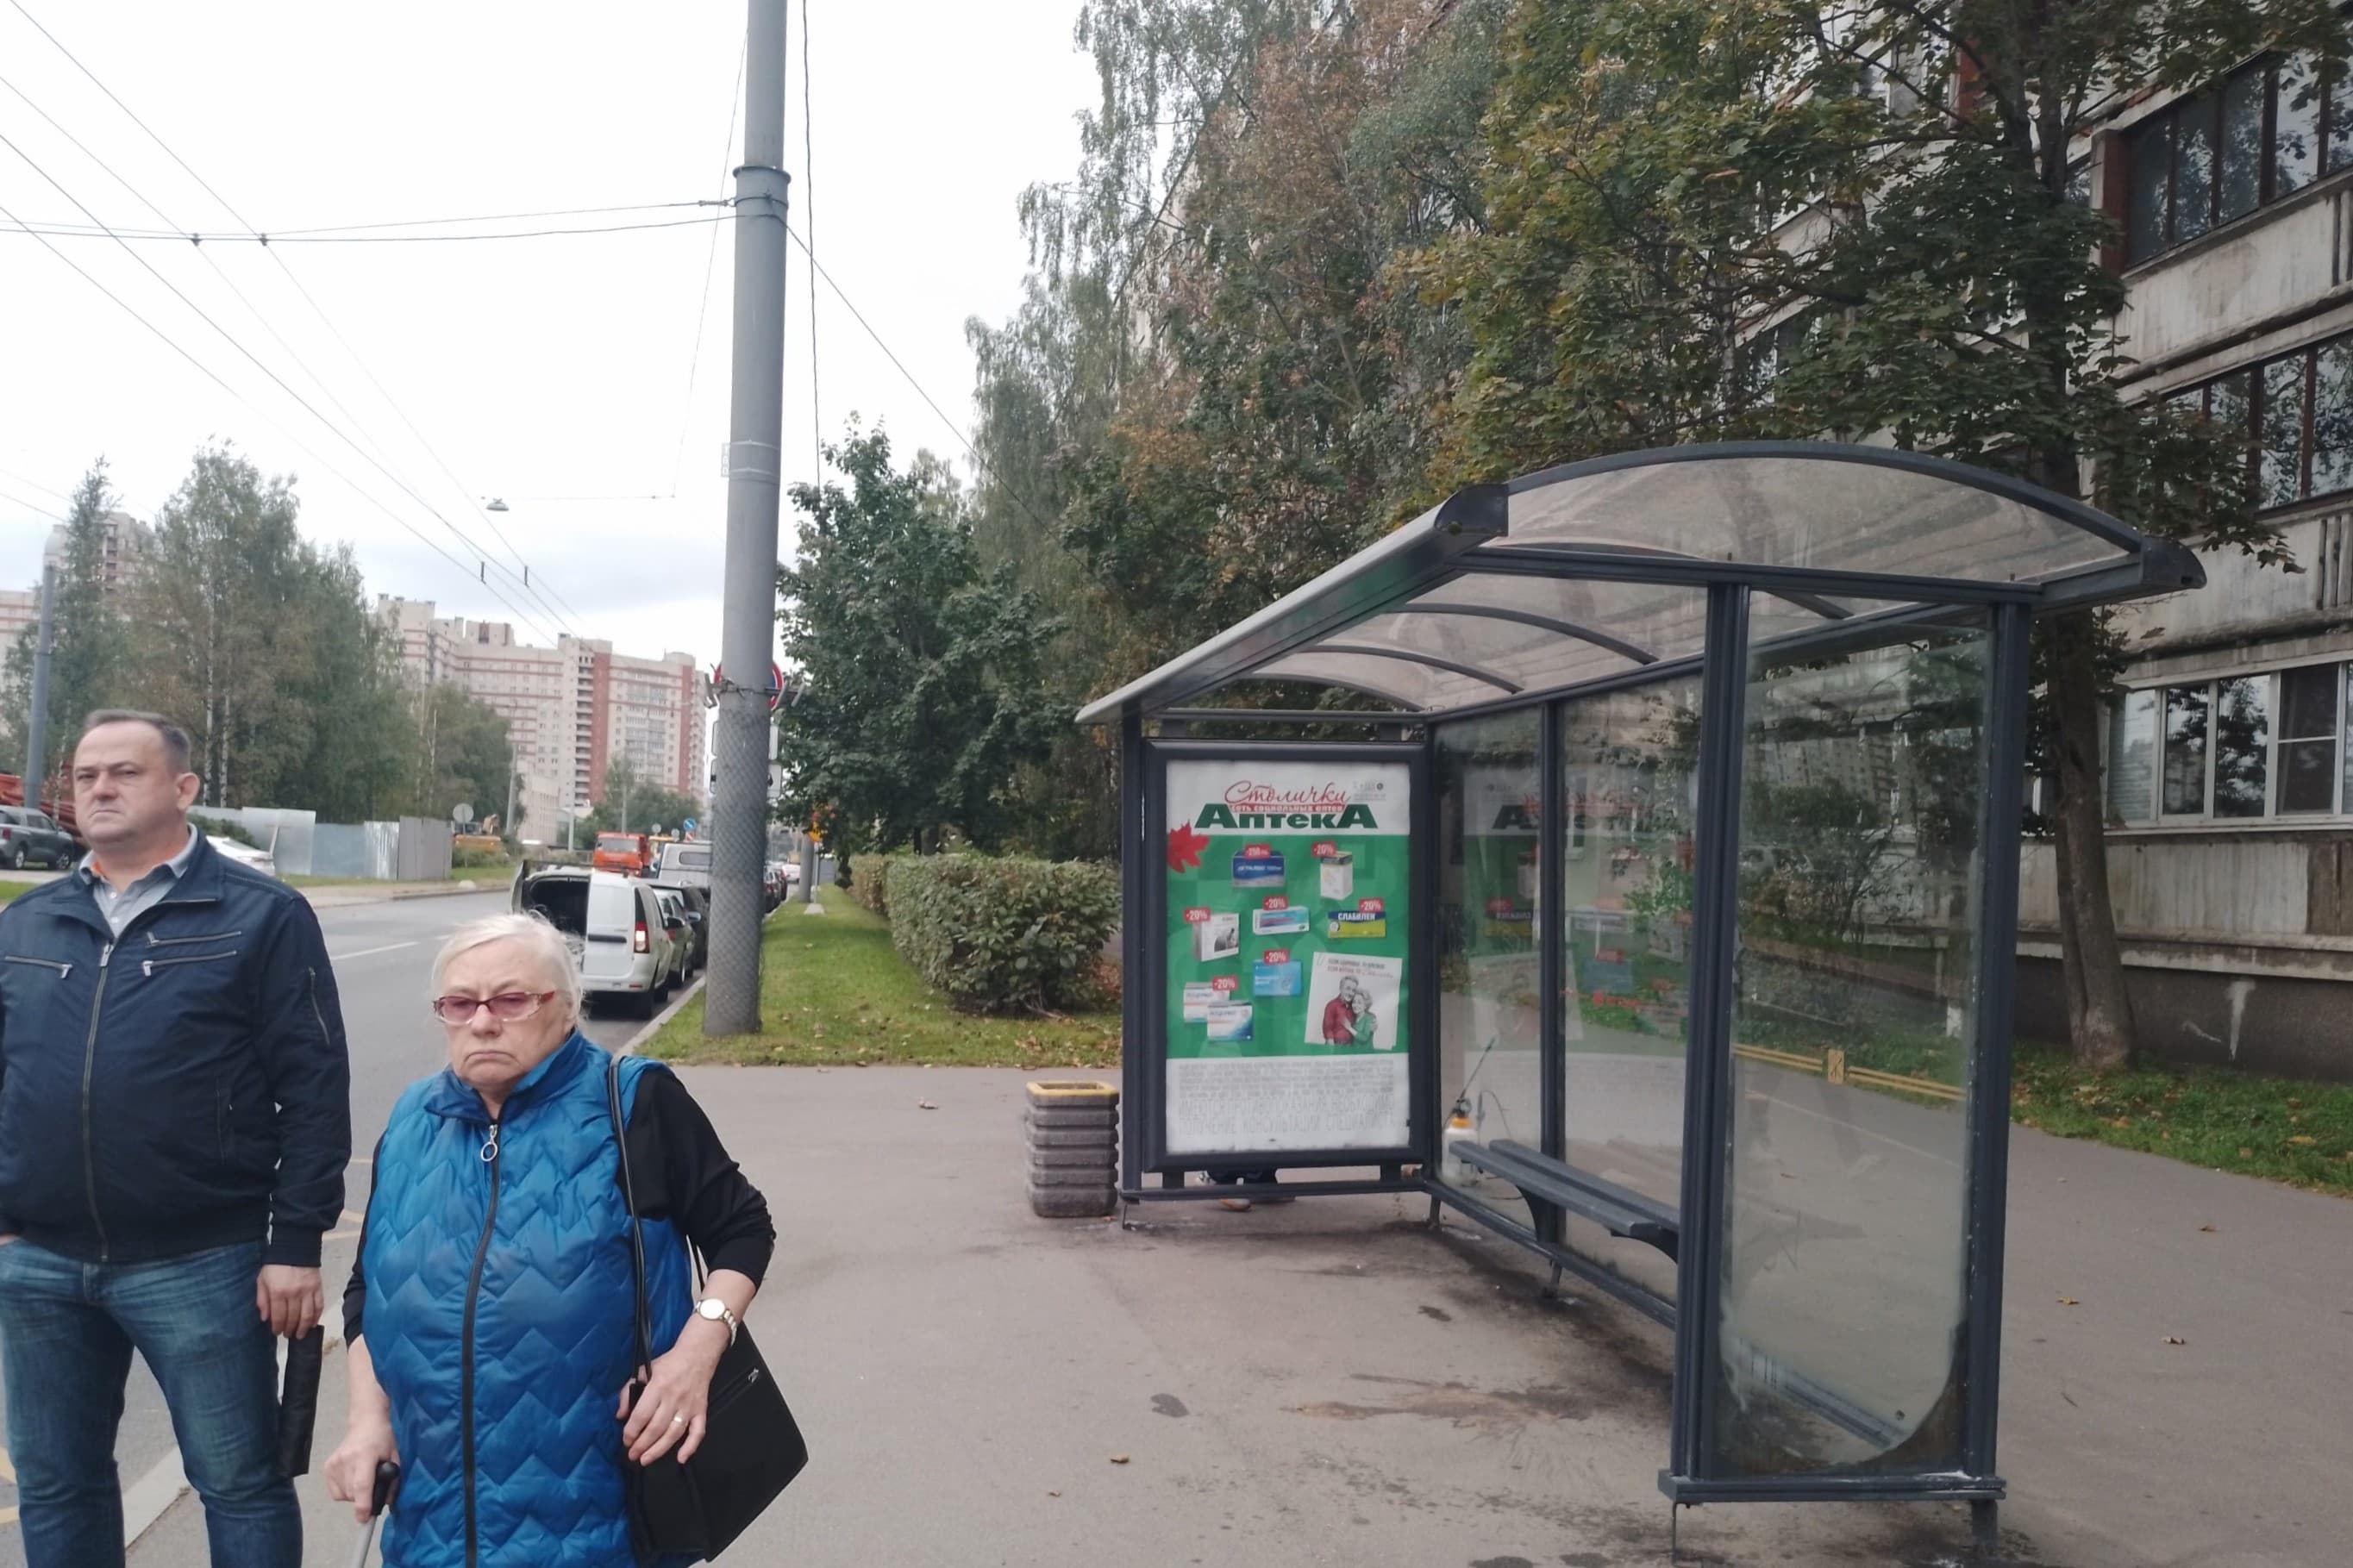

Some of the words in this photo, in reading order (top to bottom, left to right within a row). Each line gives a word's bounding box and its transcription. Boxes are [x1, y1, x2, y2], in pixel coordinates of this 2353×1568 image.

[1224, 780, 1351, 803] Столички
[1314, 844, 1335, 855] -20%
[1265, 898, 1286, 909] -20%
[1361, 900, 1381, 911] -20%
[1186, 909, 1208, 920] -20%
[1266, 952, 1286, 963] -20%
[1214, 978, 1235, 989] -20%
